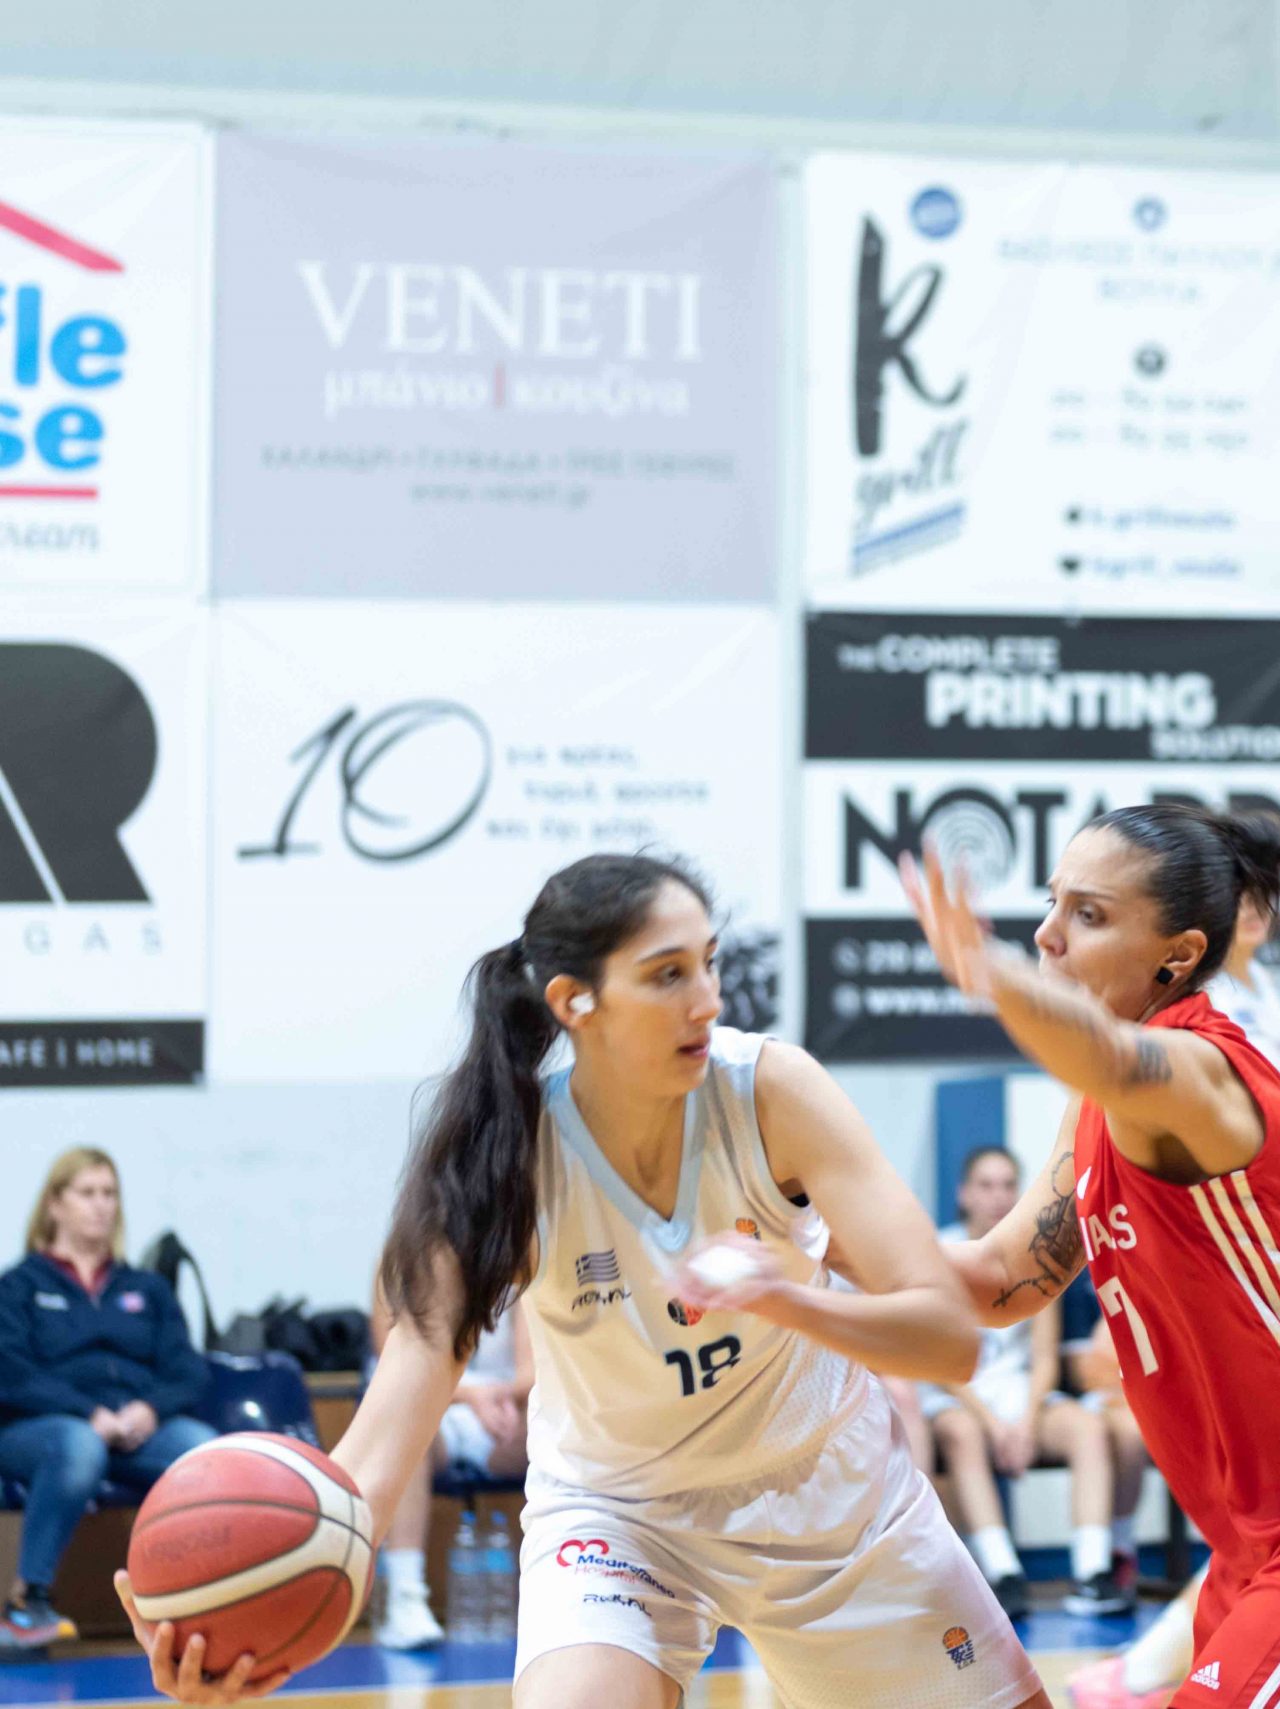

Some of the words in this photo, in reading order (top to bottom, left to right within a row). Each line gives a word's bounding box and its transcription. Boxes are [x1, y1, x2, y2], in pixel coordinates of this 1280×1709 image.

[297, 258, 703, 363] VENETI
[877, 634, 1061, 674] COMPLETE
[924, 671, 1217, 731] PRINTING
[74, 1036, 155, 1070] HOME
[664, 1334, 742, 1398] 18
